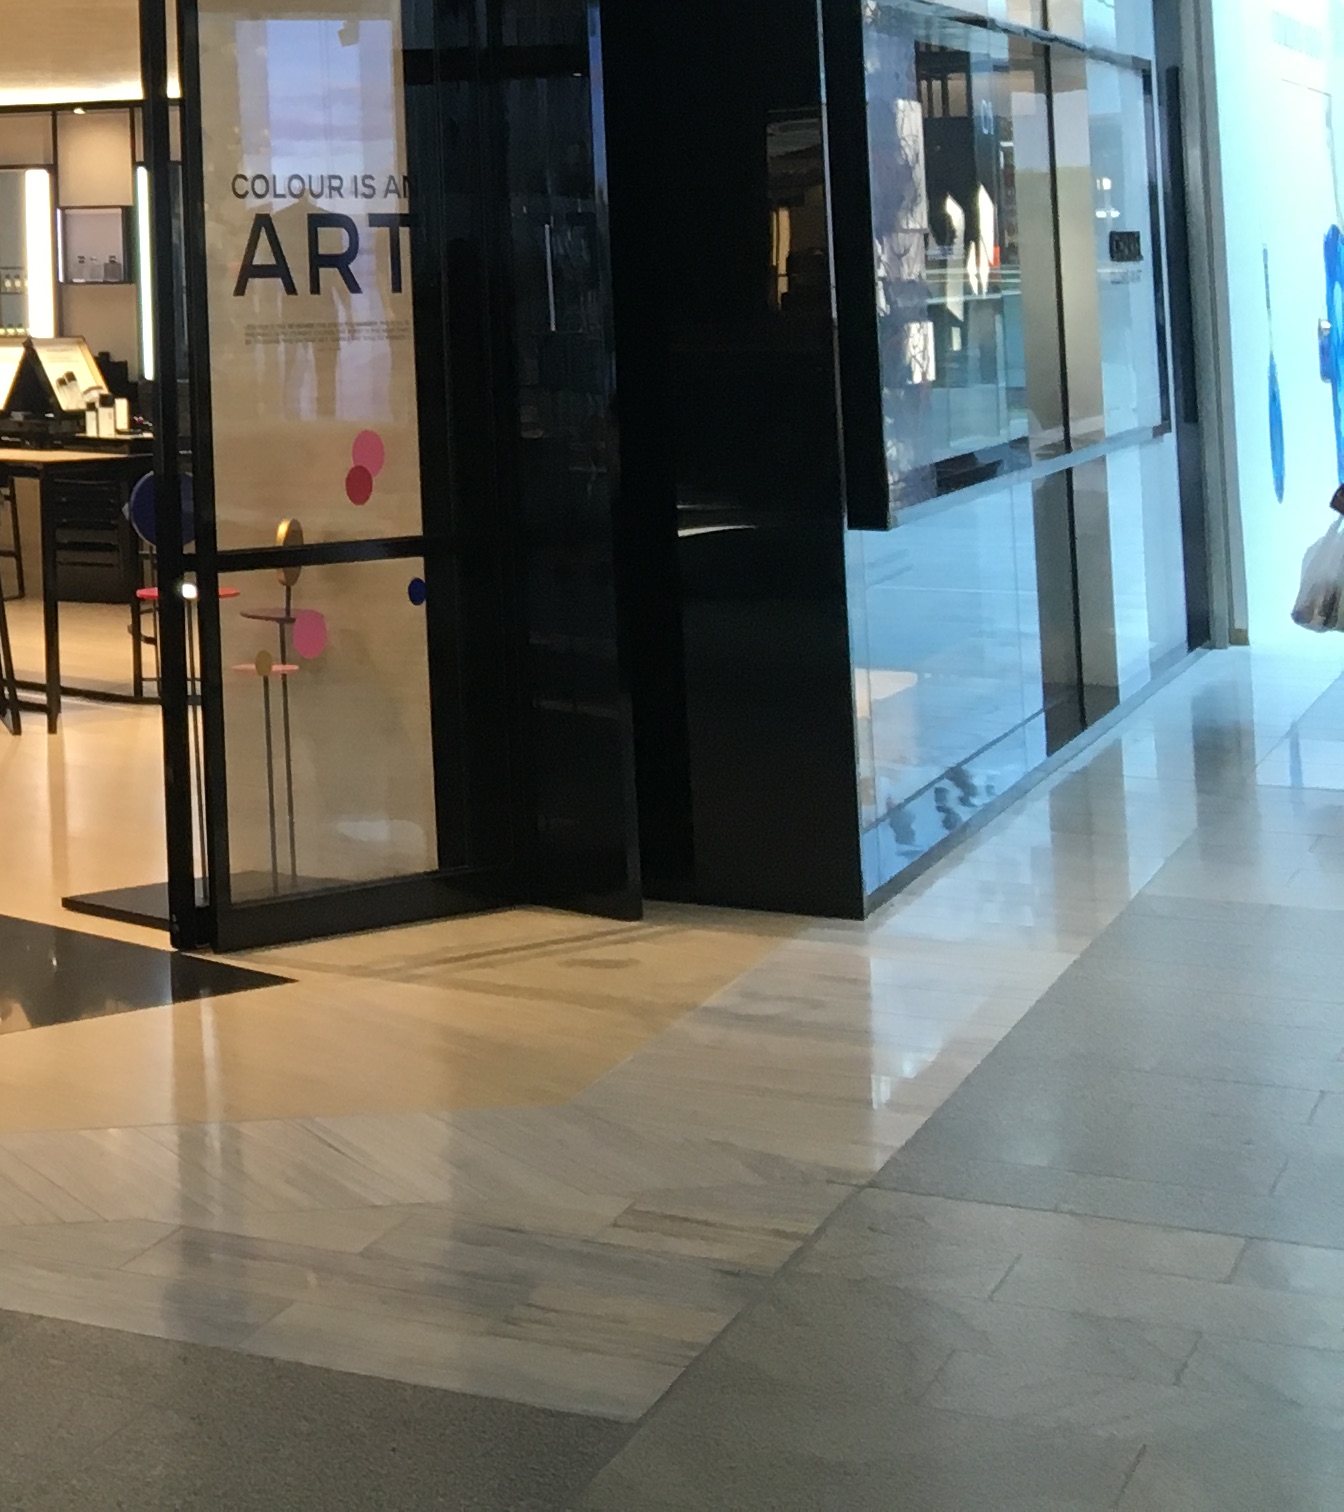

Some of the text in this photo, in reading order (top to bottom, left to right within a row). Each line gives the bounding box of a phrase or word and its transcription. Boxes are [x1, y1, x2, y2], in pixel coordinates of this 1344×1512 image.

[231, 173, 344, 199] COLOUR
[353, 173, 377, 199] IS
[232, 213, 418, 297] ART
